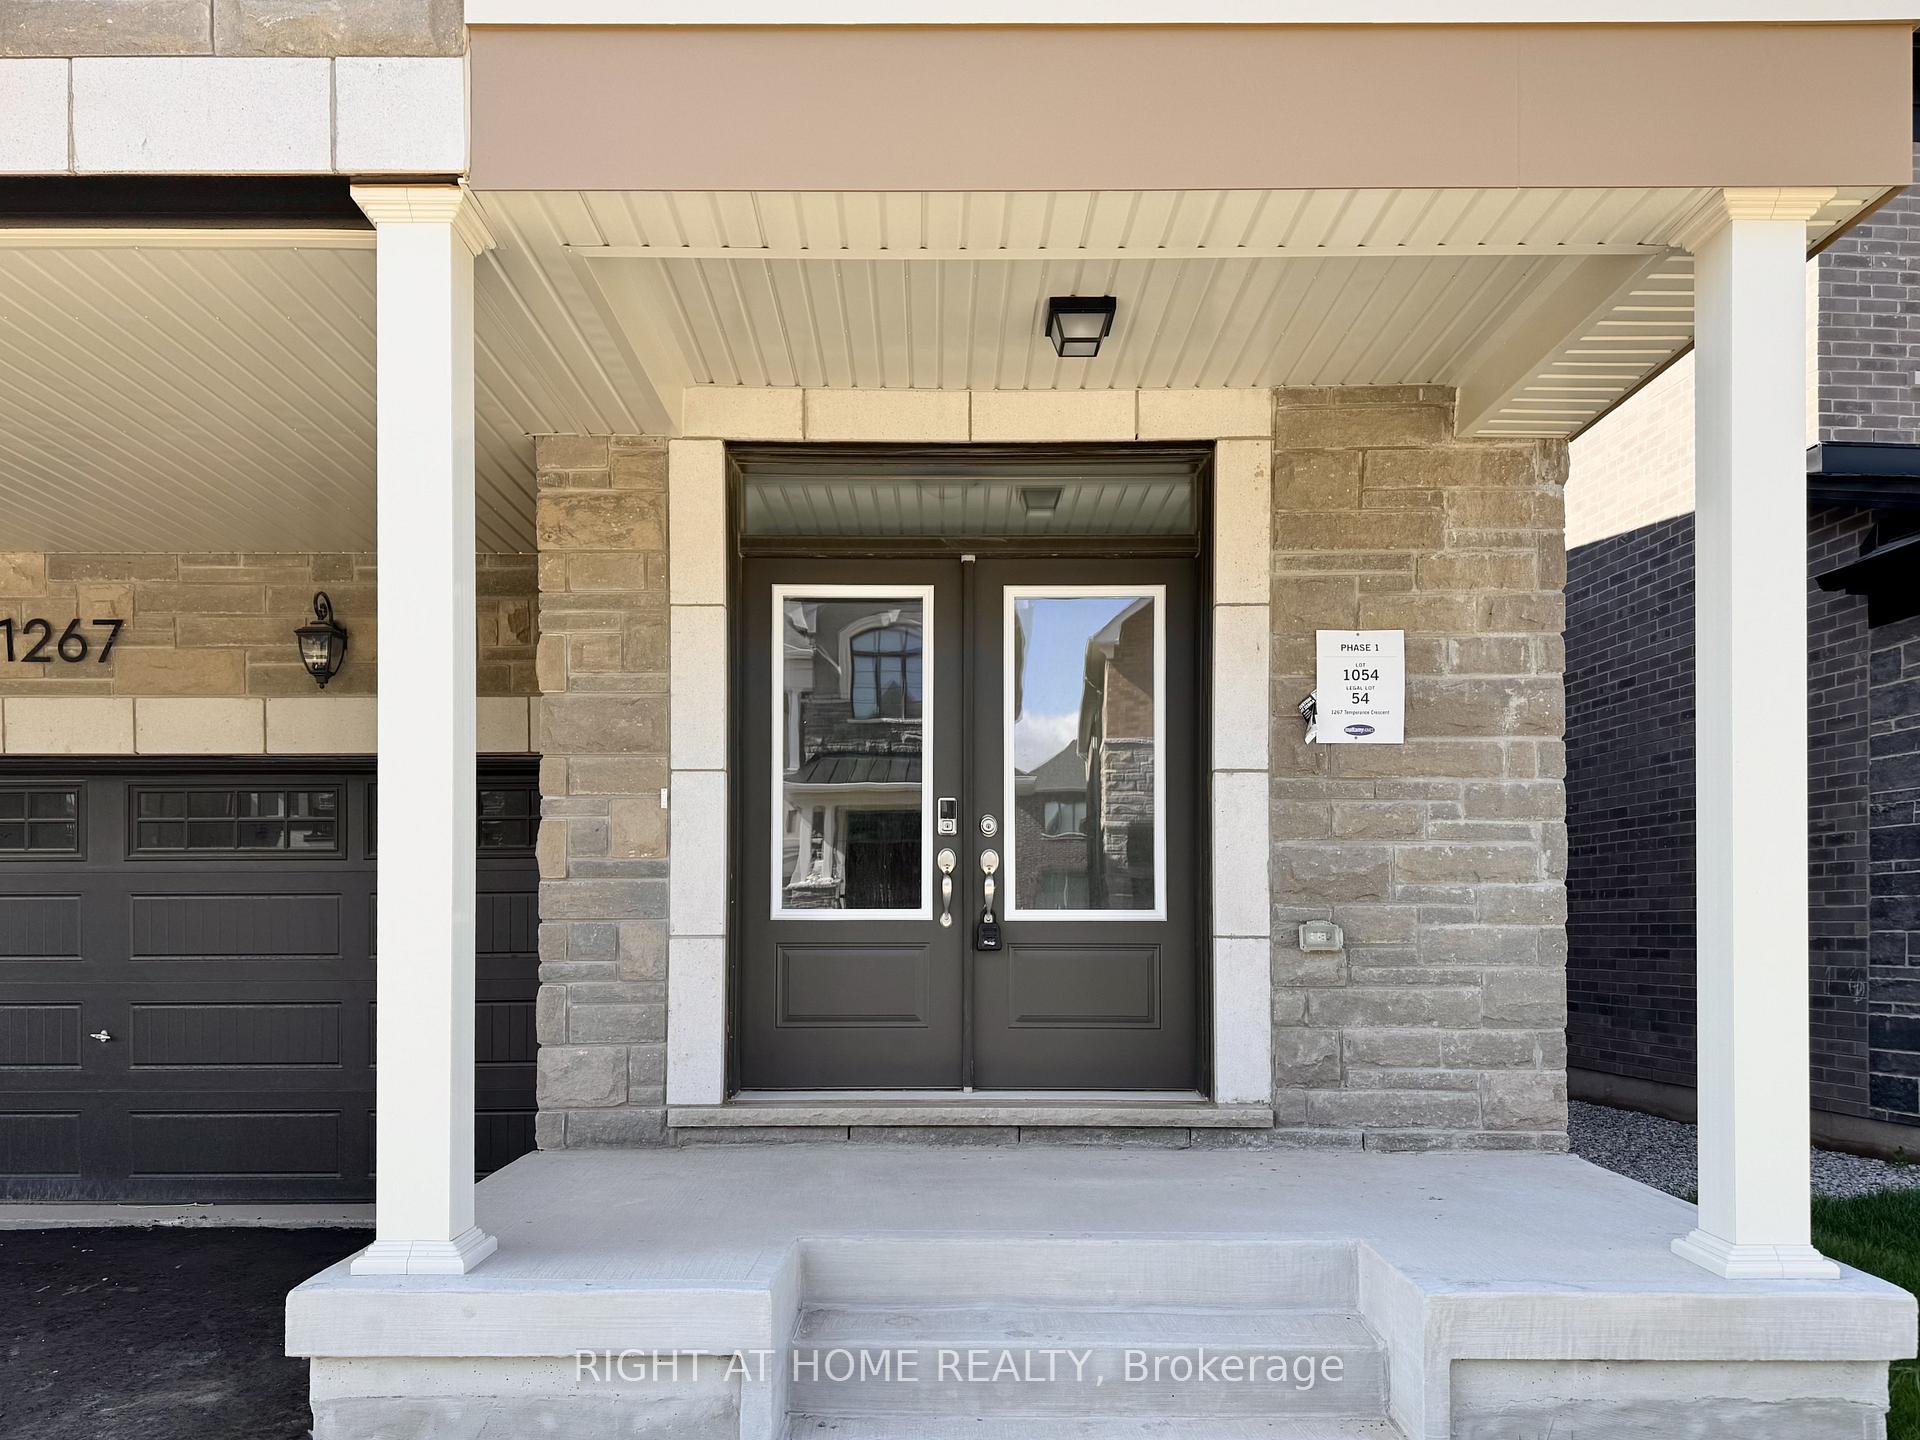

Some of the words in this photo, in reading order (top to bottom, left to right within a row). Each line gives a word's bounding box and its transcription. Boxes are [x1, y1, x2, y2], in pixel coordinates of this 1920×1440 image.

[0, 617, 124, 662] 1267
[1340, 643, 1371, 652] PHASE
[1375, 643, 1380, 652] 1
[1343, 669, 1380, 681] 1054
[1351, 692, 1370, 704] 54
